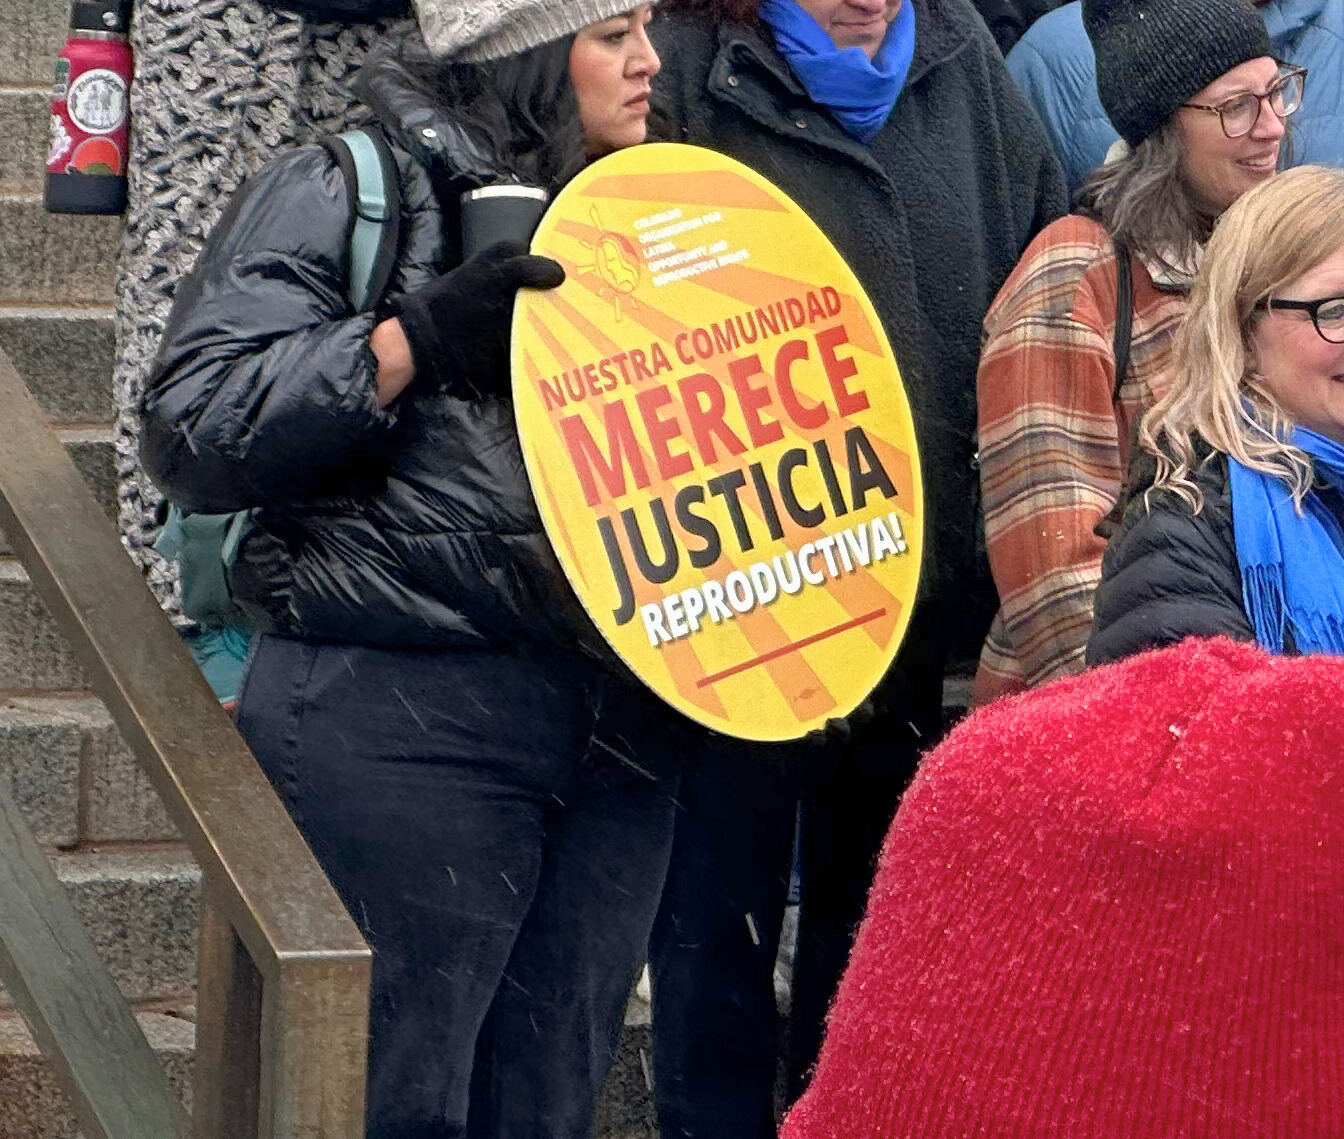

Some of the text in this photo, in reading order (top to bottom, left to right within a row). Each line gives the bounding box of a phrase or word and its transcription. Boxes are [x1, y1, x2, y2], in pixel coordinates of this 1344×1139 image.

[538, 286, 842, 412] NUESTRA COMUNIDAD
[560, 325, 870, 507] MERECE
[597, 426, 899, 626] JUSTICIA
[639, 512, 907, 647] REPRODUCTIVA!
